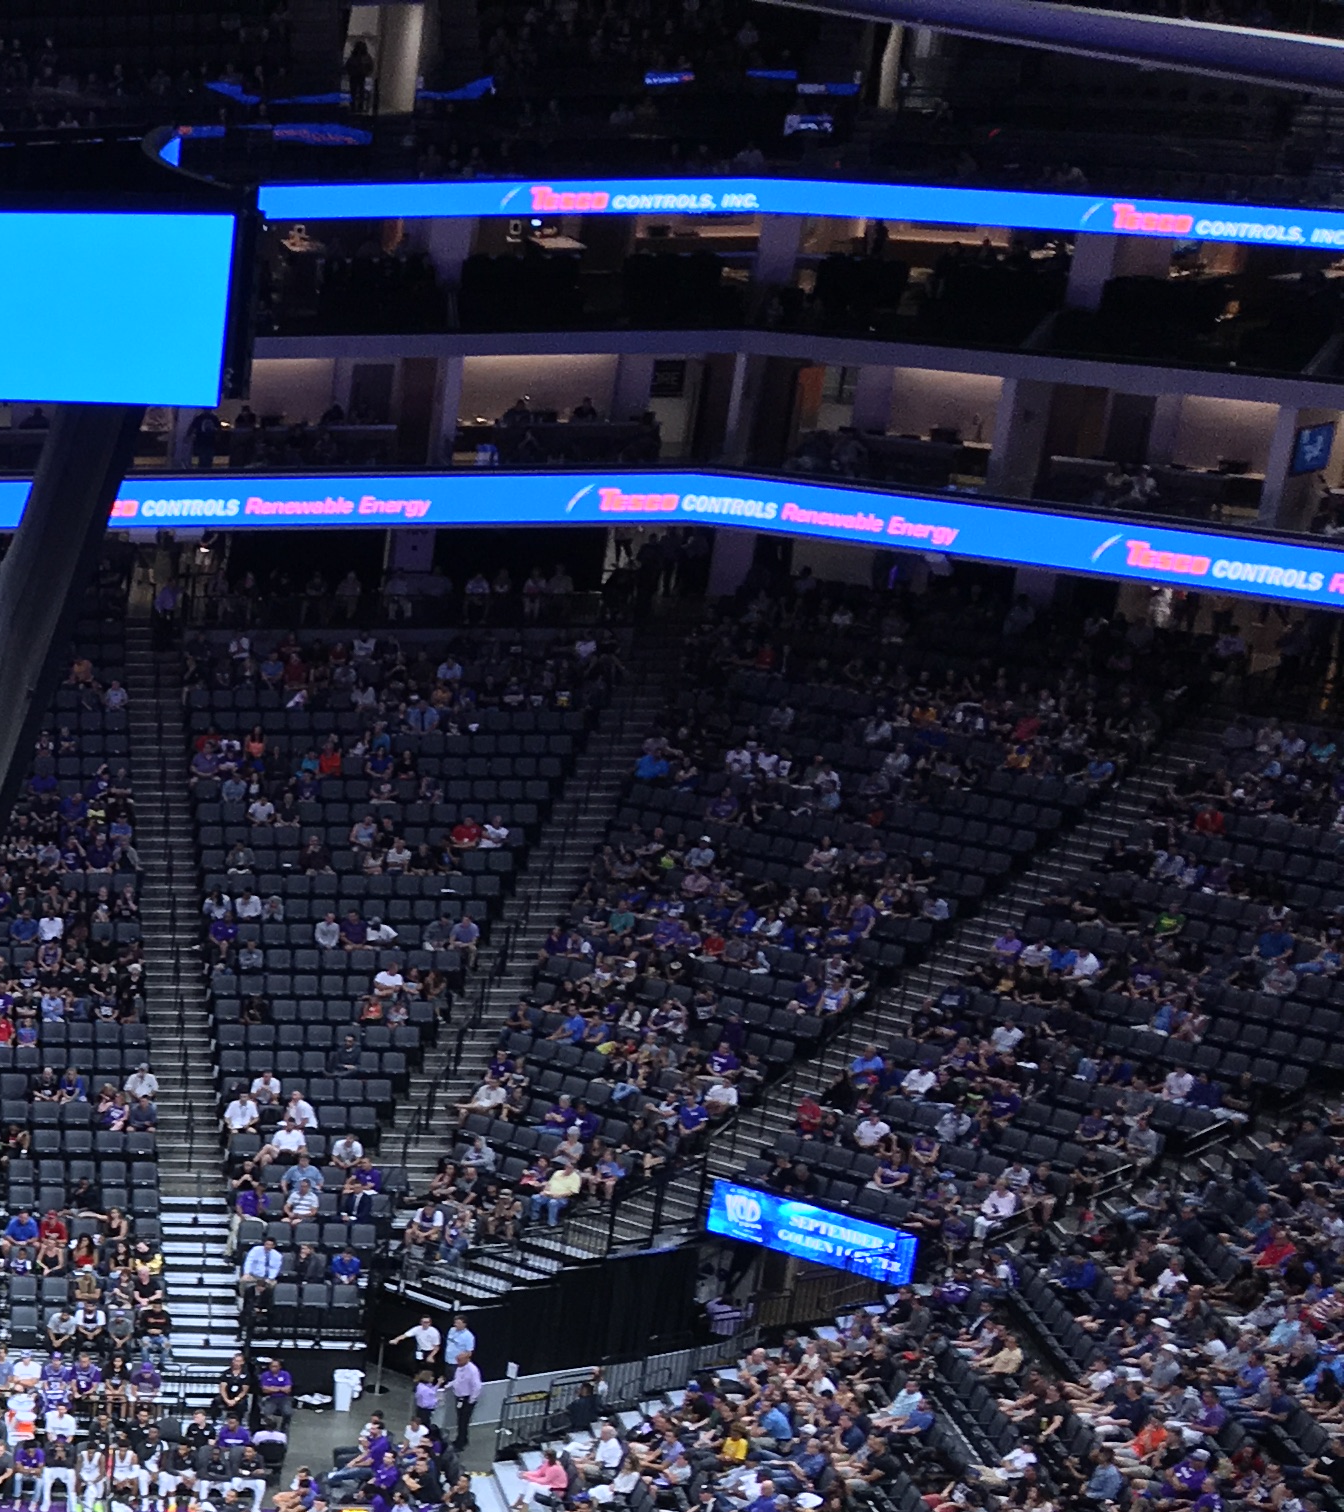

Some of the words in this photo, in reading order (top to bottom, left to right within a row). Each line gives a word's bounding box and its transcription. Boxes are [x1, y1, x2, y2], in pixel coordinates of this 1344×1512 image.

[529, 187, 608, 212] TESCO
[1112, 204, 1193, 233] TESCO
[142, 499, 240, 518] CONTROLS
[245, 497, 354, 517] Renewable
[357, 496, 432, 518] Energy
[682, 493, 778, 521] CONTROLS
[780, 501, 885, 536] Renewable
[888, 516, 960, 546] Energy
[1213, 558, 1324, 593] CONTROLS
[788, 1214, 884, 1248] SEPTEMBER
